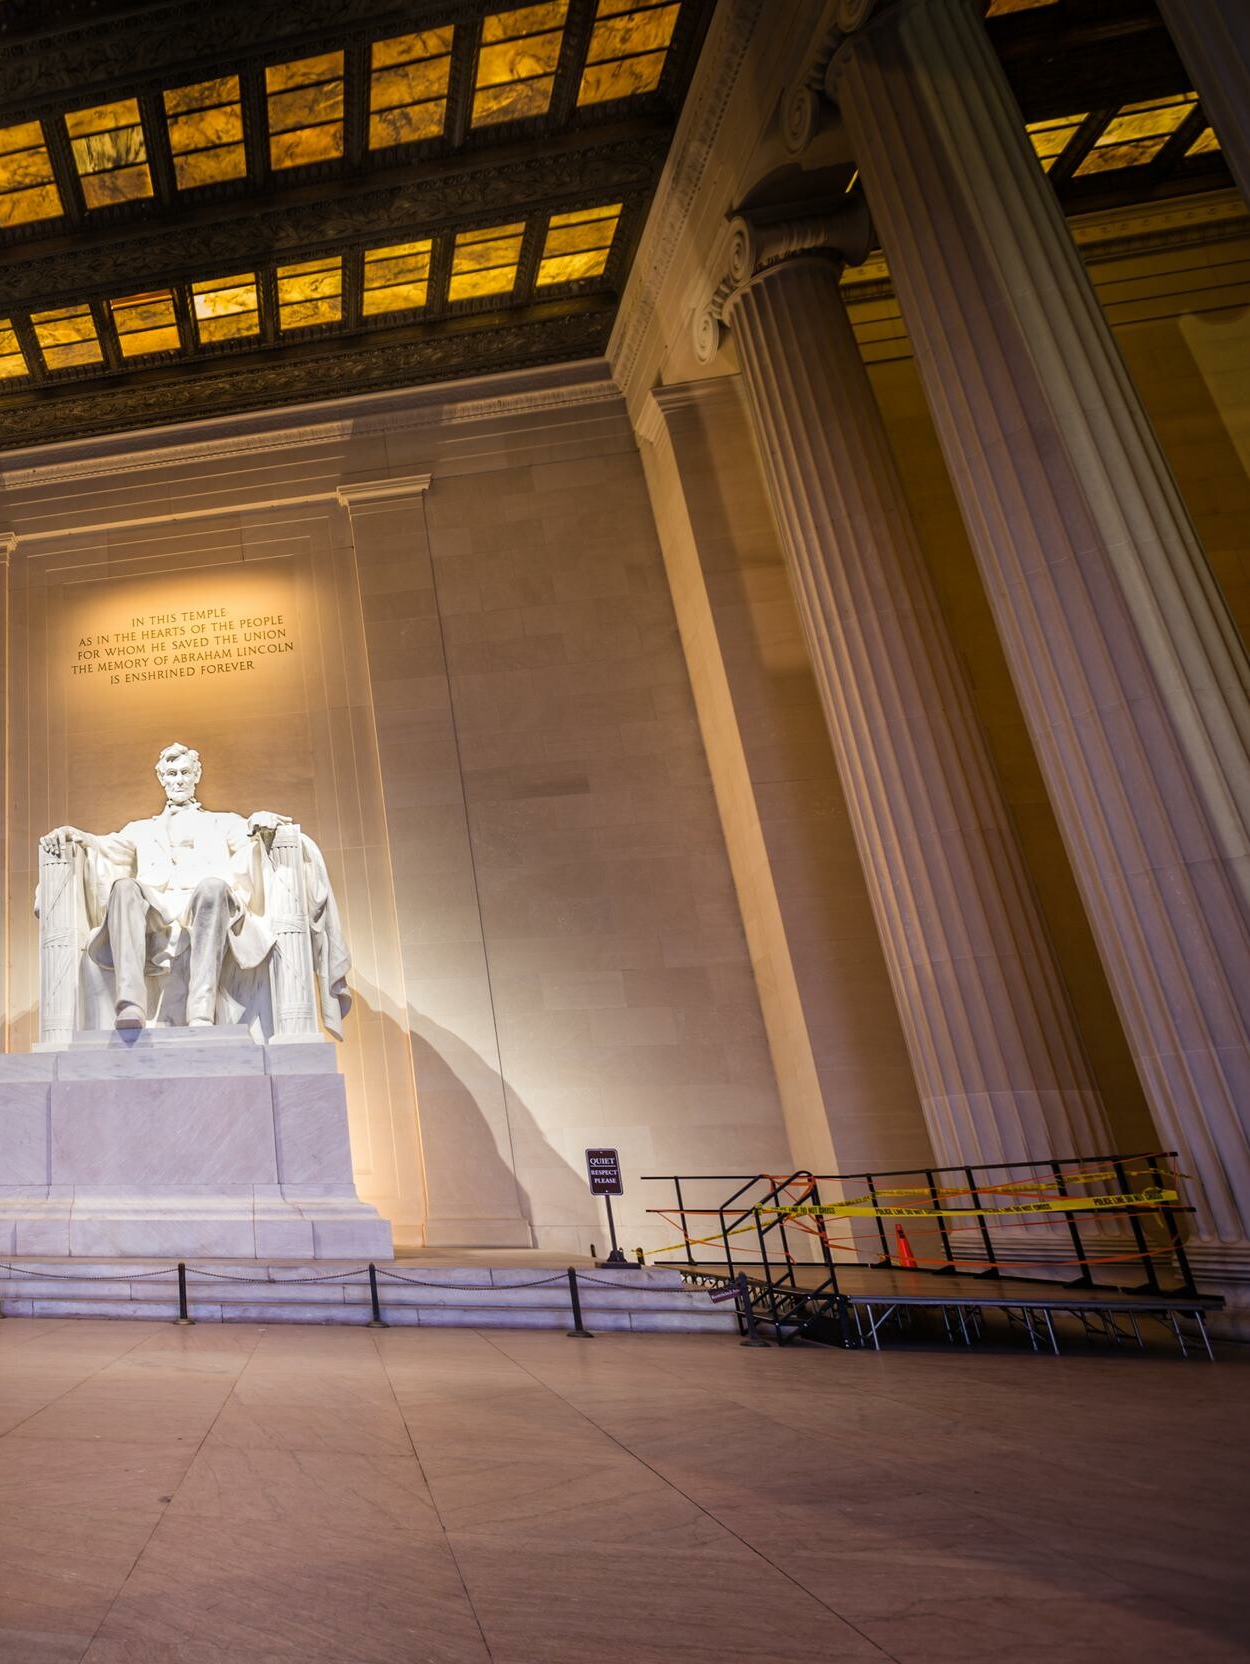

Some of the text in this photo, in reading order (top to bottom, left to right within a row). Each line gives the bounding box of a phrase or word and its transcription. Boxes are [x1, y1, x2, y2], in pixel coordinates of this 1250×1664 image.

[78, 614, 284, 648] AS IN THE HEARTS OF THE PEOPLE
[132, 607, 227, 627] IN THIS TEMPLE
[71, 641, 294, 675] THE MEMORY OF ABRAHAM LINCOLN
[78, 628, 286, 661] FOR WHOM HE SAVED THE UNION
[110, 660, 255, 685] IS ENSHRINED FOREVER
[590, 1157, 615, 1165] QUIET
